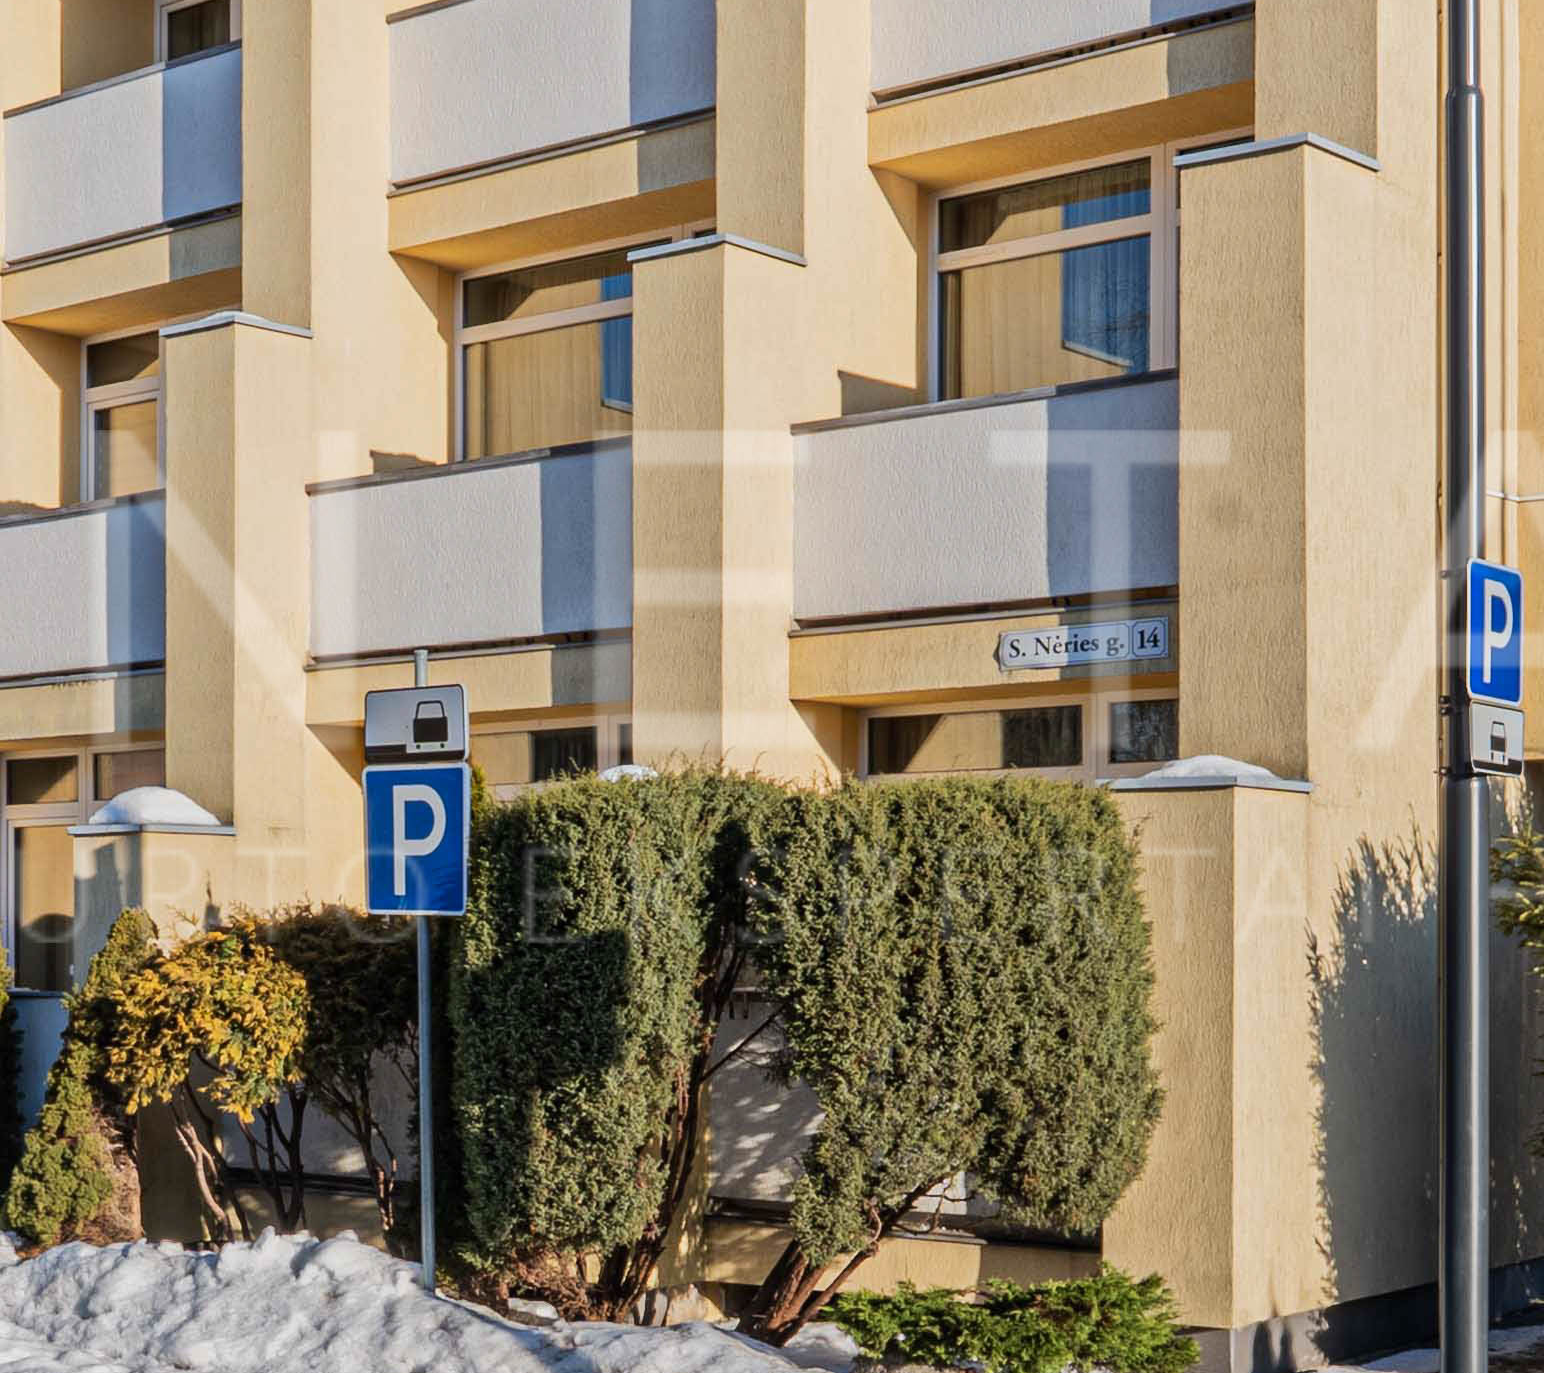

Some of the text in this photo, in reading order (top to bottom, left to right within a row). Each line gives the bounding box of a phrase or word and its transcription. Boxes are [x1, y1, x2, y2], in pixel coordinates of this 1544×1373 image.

[1009, 626, 1161, 658] S. Nėries g. 14
[1483, 578, 1513, 684] P
[393, 784, 447, 896] P
